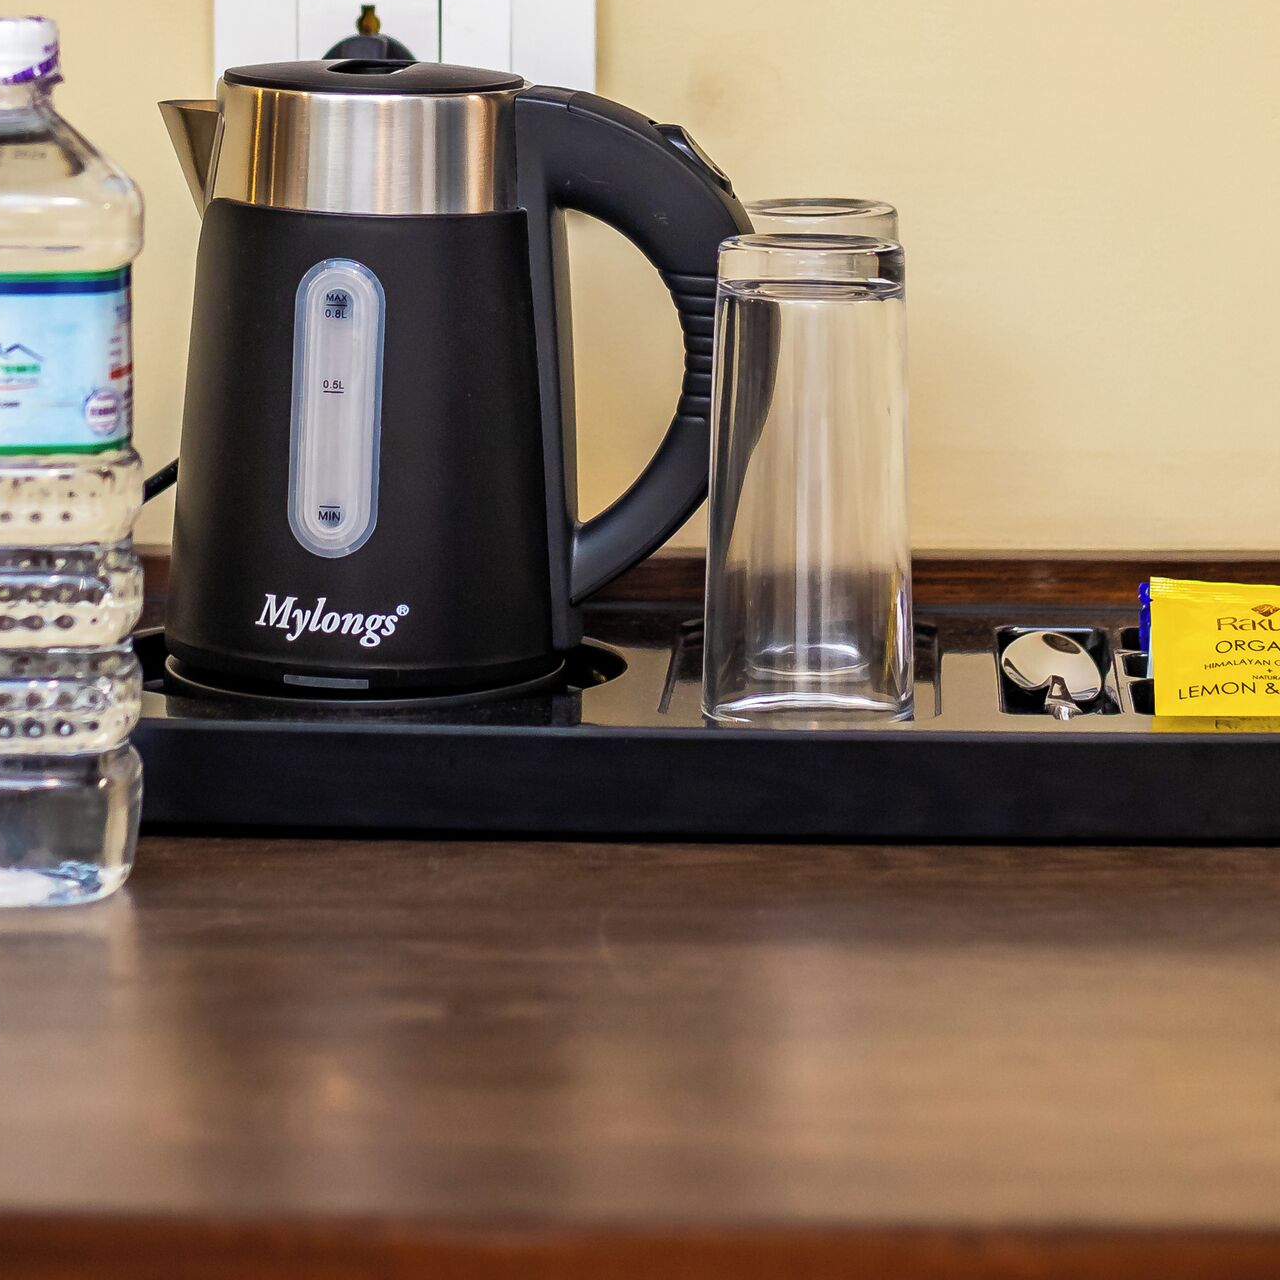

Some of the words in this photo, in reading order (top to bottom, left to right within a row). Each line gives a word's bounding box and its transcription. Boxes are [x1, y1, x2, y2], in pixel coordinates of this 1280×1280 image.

[325, 293, 348, 303] MAX
[324, 308, 348, 320] 0.8L
[322, 380, 345, 391] 0.5L
[318, 511, 341, 522] MIN
[1204, 659, 1271, 670] HIMALAYAN
[1178, 681, 1257, 700] LEMON
[1264, 681, 1280, 695] &
